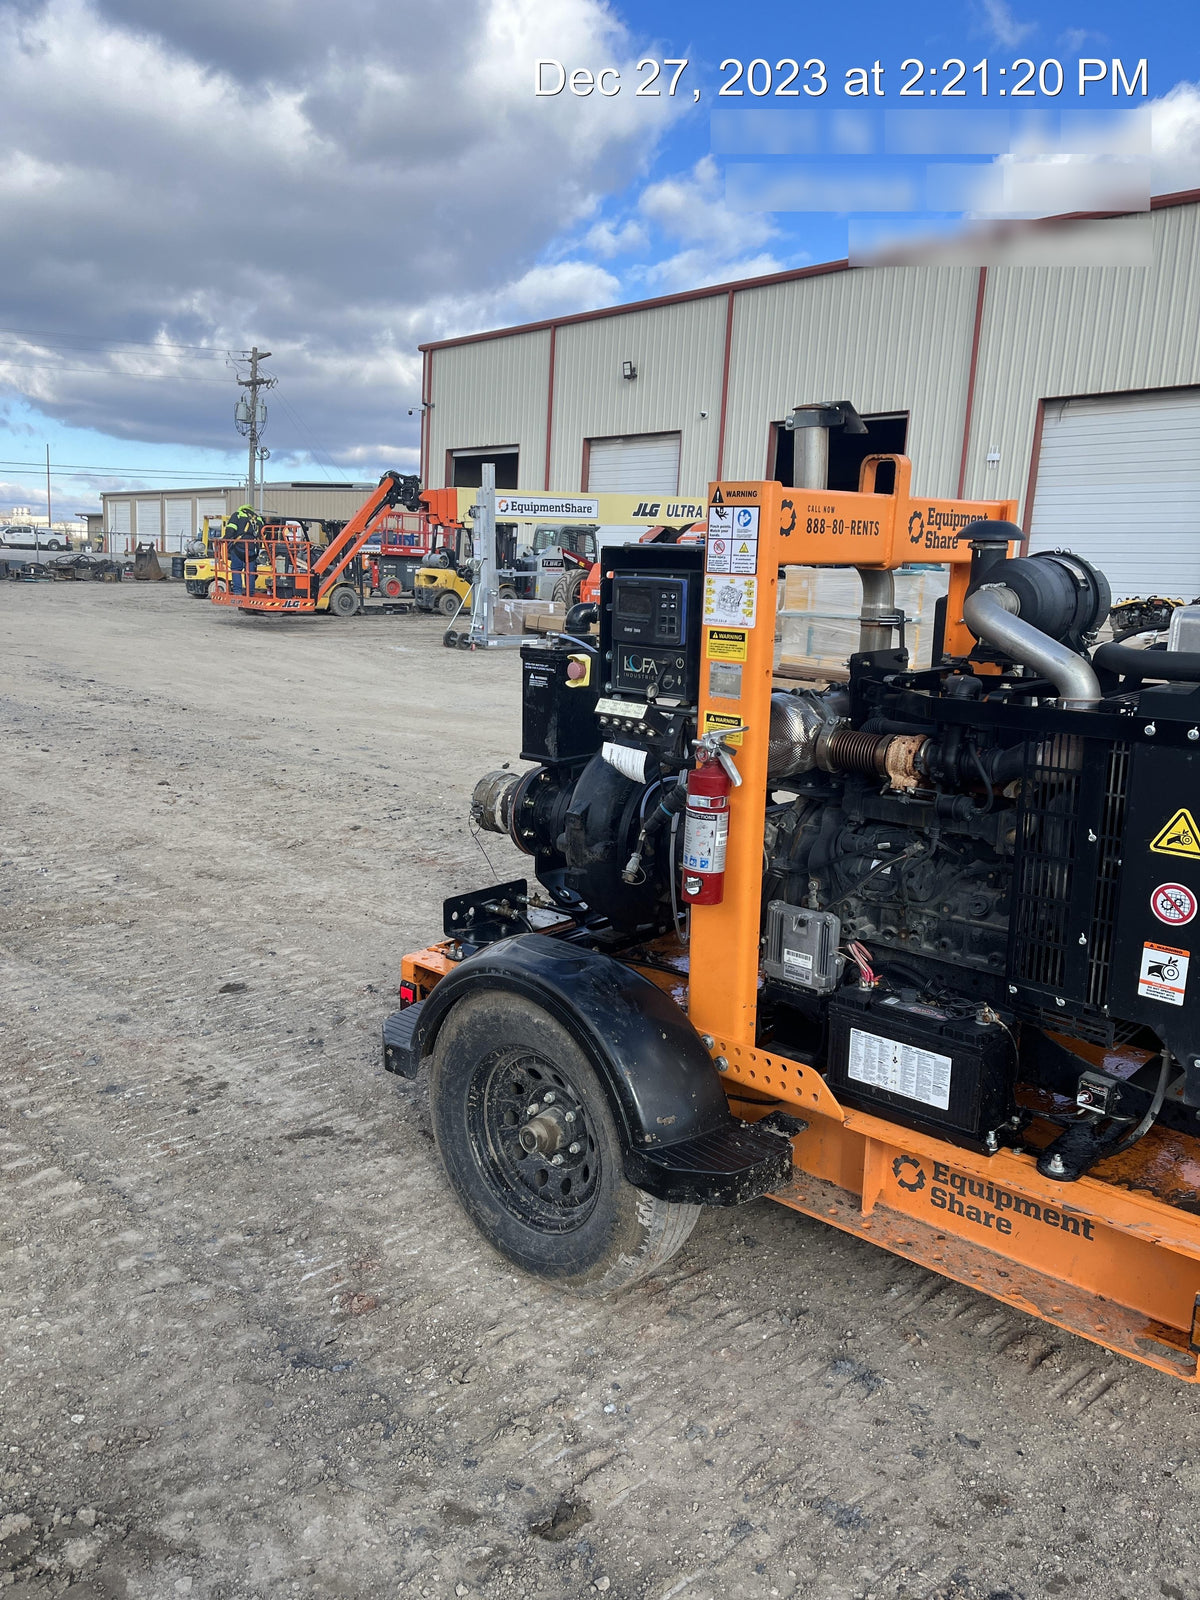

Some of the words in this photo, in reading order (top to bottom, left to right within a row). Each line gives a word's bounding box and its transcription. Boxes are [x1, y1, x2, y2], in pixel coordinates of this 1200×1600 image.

[726, 490, 758, 498] WARNING
[510, 501, 593, 514] EquipmentShare
[632, 503, 661, 517] JLG
[666, 504, 703, 518] ULTRA
[807, 505, 821, 513] CALL
[823, 506, 835, 514] NOW
[806, 518, 880, 536] 888-80-RENTS
[925, 531, 958, 549] Share
[282, 600, 300, 608] JLG
[719, 633, 742, 641] WARNING
[624, 654, 658, 675] LOFA
[715, 717, 739, 725] WARNING
[1156, 946, 1183, 954] WARNING
[932, 1161, 1095, 1242] Equipment
[930, 1186, 1012, 1236] Share
